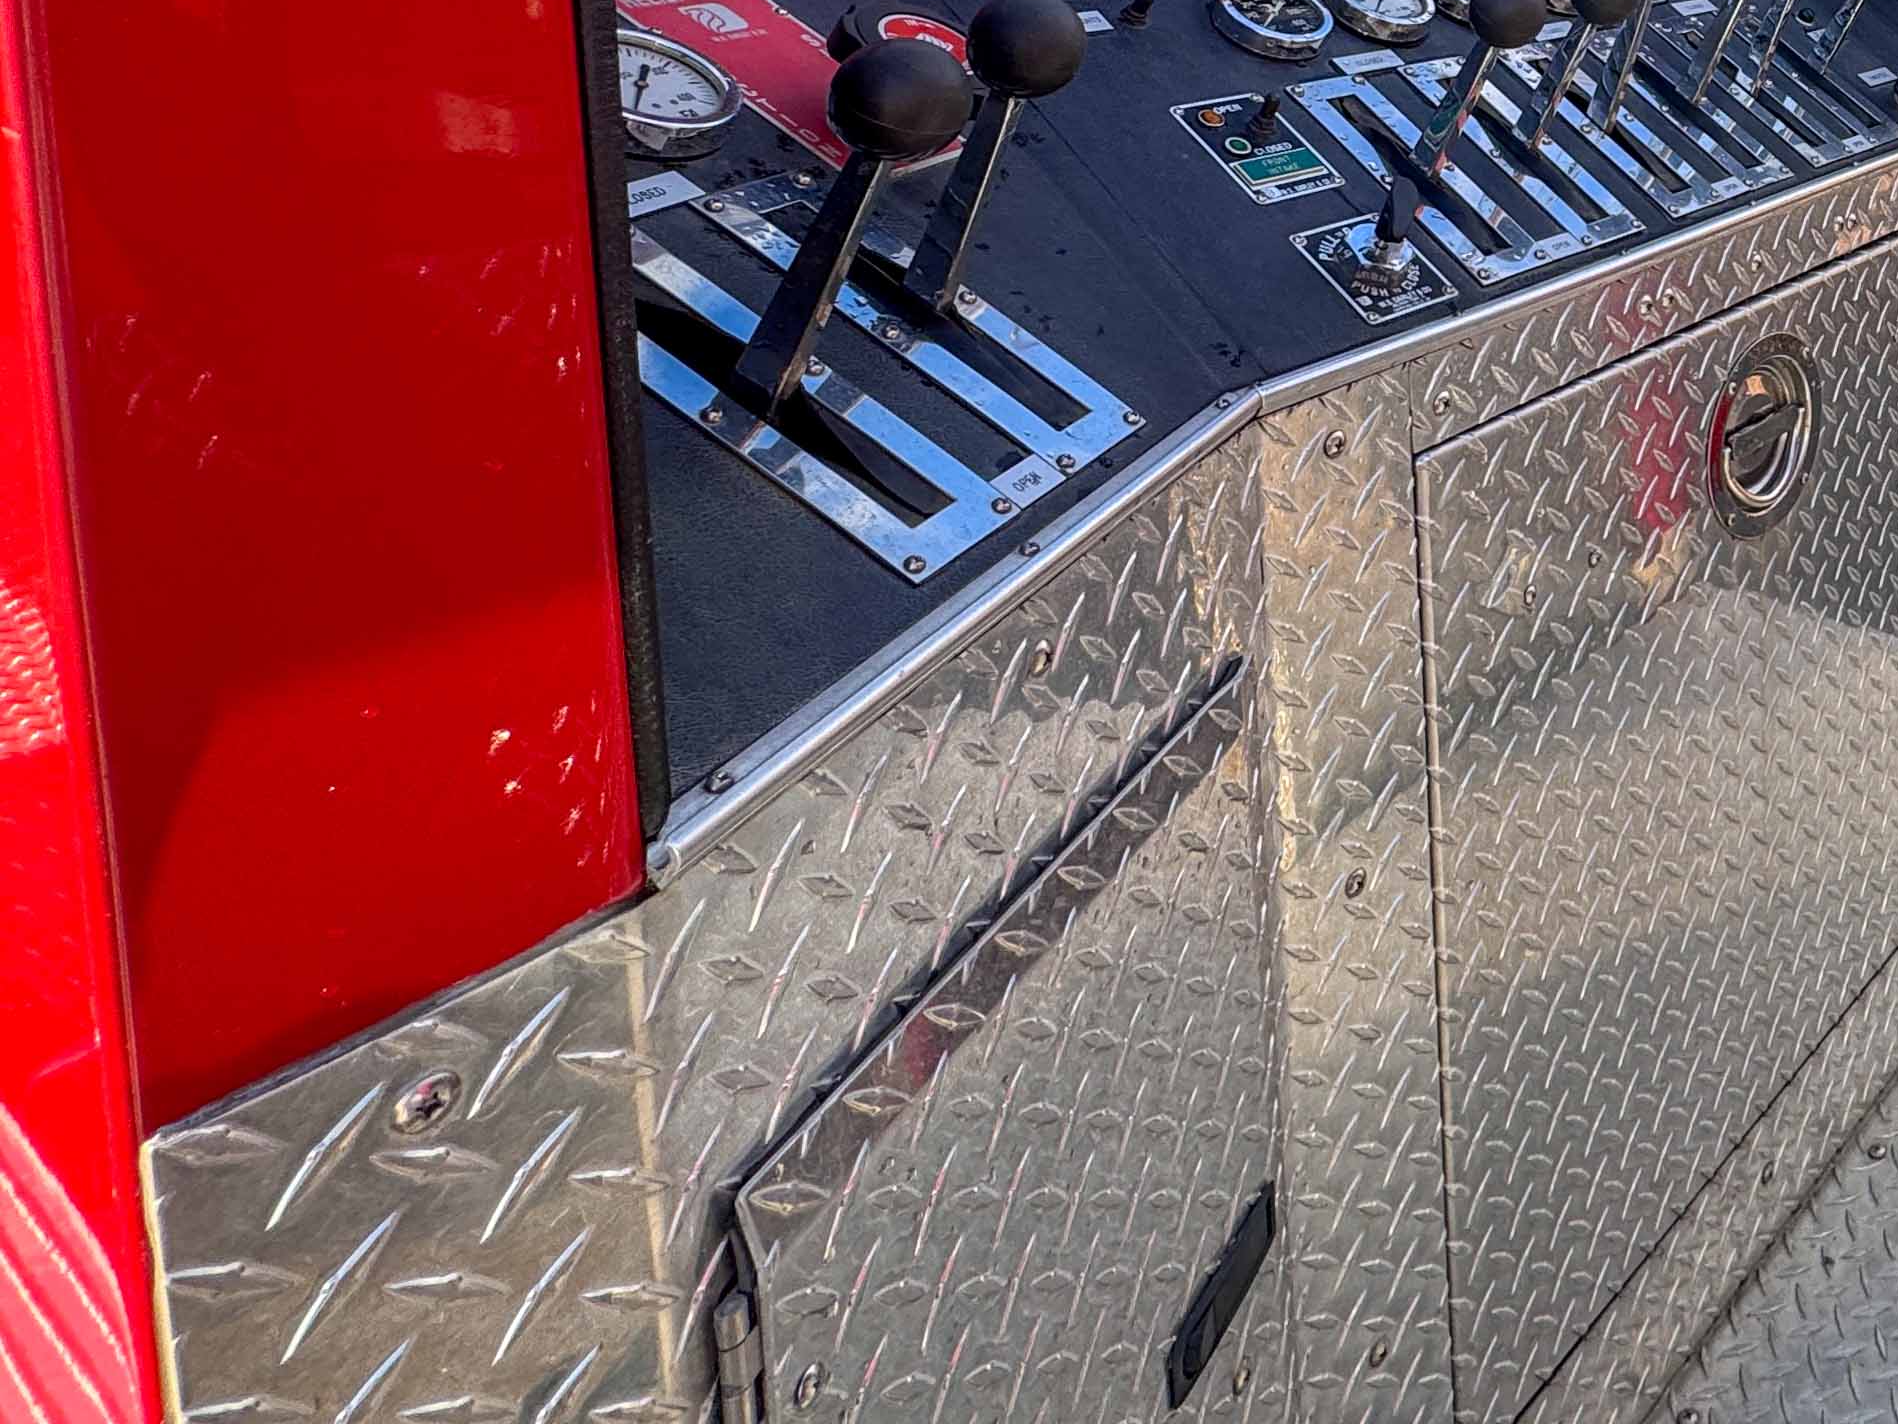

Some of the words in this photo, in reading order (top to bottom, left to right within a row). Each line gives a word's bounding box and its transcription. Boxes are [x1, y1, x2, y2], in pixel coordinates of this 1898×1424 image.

[1213, 103, 1243, 115] OPEN
[1253, 142, 1293, 156] CLOSED
[1261, 155, 1290, 167] FRONT
[629, 184, 667, 205] LOSED
[1318, 235, 1338, 262] PULL
[1351, 281, 1389, 297] PUSH
[1401, 263, 1421, 290] CLOSE
[1011, 470, 1042, 492] OPEN
